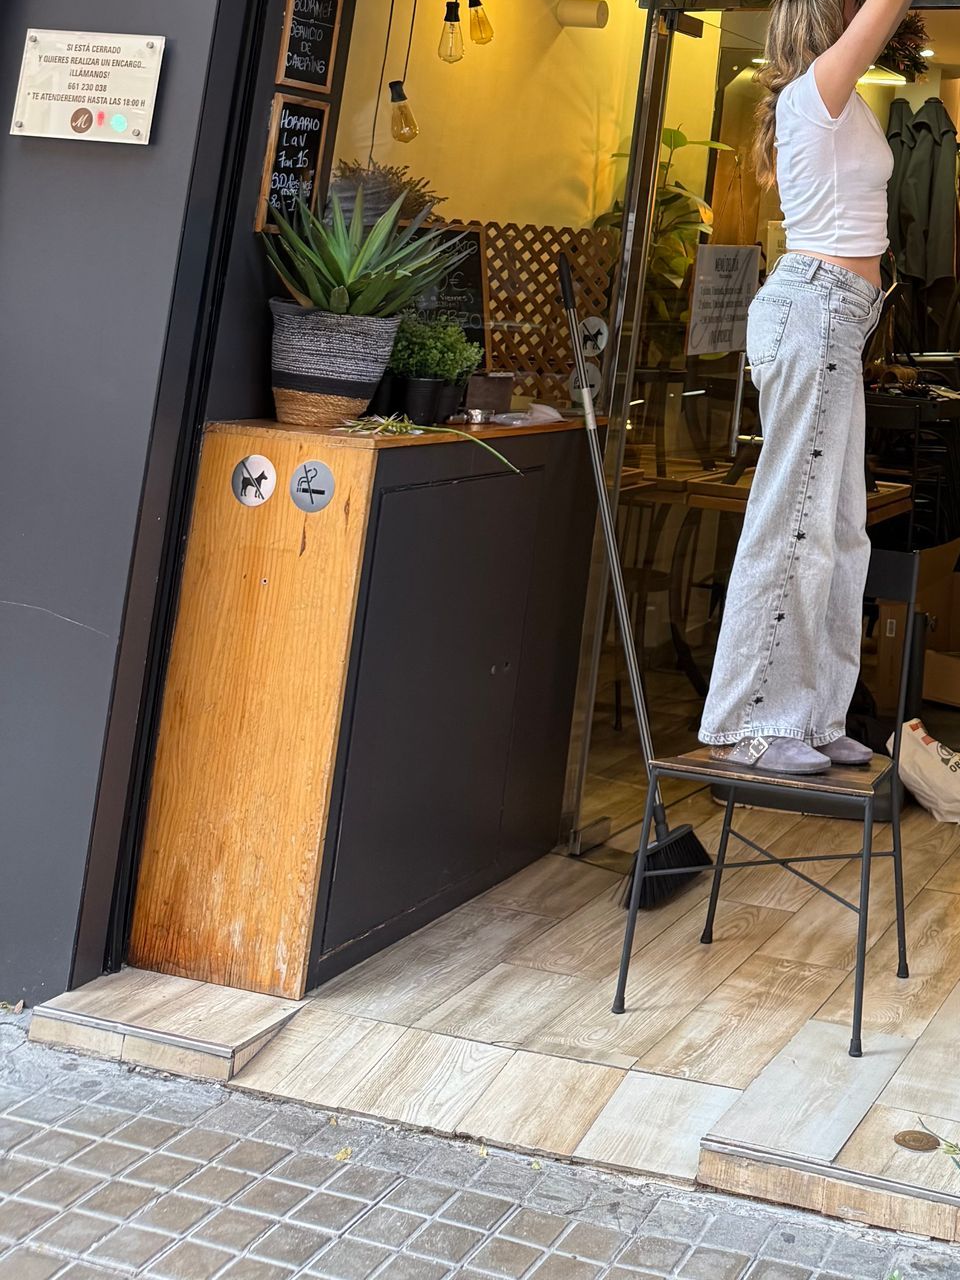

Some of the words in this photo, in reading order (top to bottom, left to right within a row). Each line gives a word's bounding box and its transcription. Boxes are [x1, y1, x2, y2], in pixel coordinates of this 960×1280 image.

[66, 43, 74, 52] SI
[74, 42, 91, 53] ESTÁ
[91, 45, 122, 55] CERRADO
[300, 41, 312, 55] DE
[43, 55, 70, 64] QUIERES
[70, 56, 100, 66] REALIZAR
[101, 58, 111, 67] UN
[69, 67, 110, 79] ¡LLÁMANOS!
[67, 82, 79, 91] 661
[81, 83, 94, 92] 230
[95, 84, 107, 92] 038
[32, 92, 40, 100] TE
[40, 93, 86, 104] ATENDEREMOS
[87, 96, 108, 105] HASTA
[109, 97, 121, 106] LAS
[123, 98, 140, 107] 18:00
[280, 109, 320, 131] HORARIO
